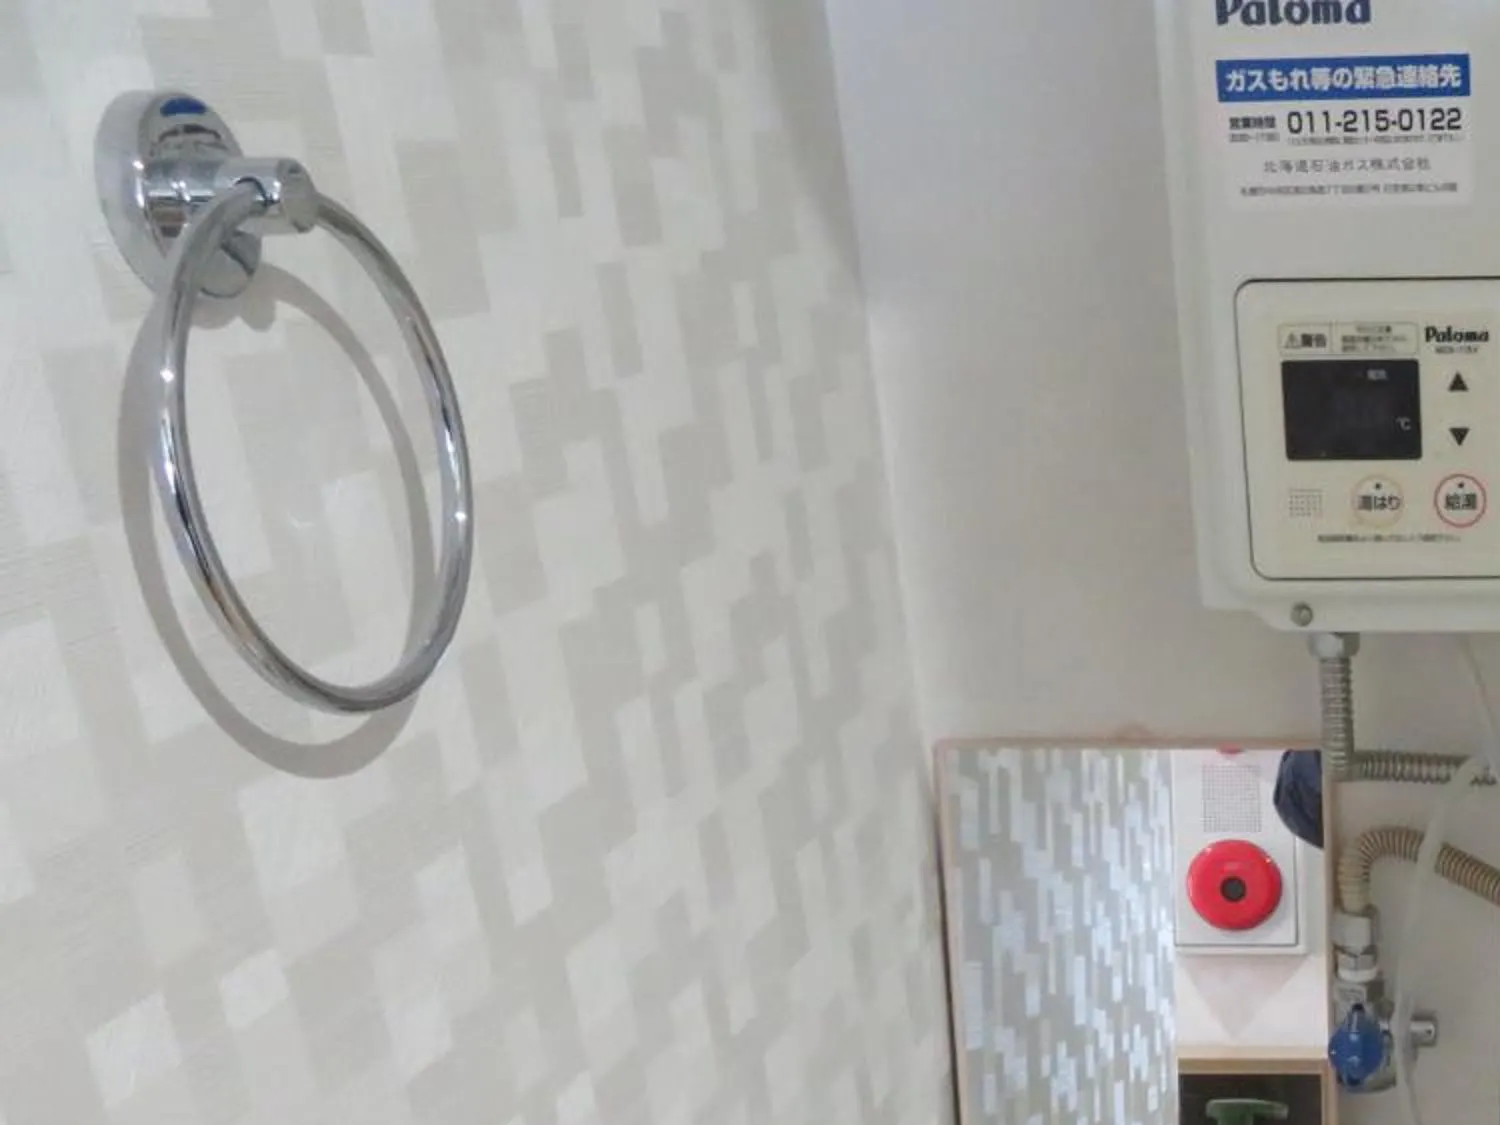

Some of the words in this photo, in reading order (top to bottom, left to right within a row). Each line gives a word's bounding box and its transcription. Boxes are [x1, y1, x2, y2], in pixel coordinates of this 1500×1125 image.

[1216, 0, 1371, 25] Paloma
[1225, 64, 1461, 92] ガスもれ等の緊急連絡先
[1287, 107, 1462, 134] 011-215-0122
[1263, 157, 1431, 174] 北海道石油ガス株式会社
[1425, 326, 1489, 342] Paloma
